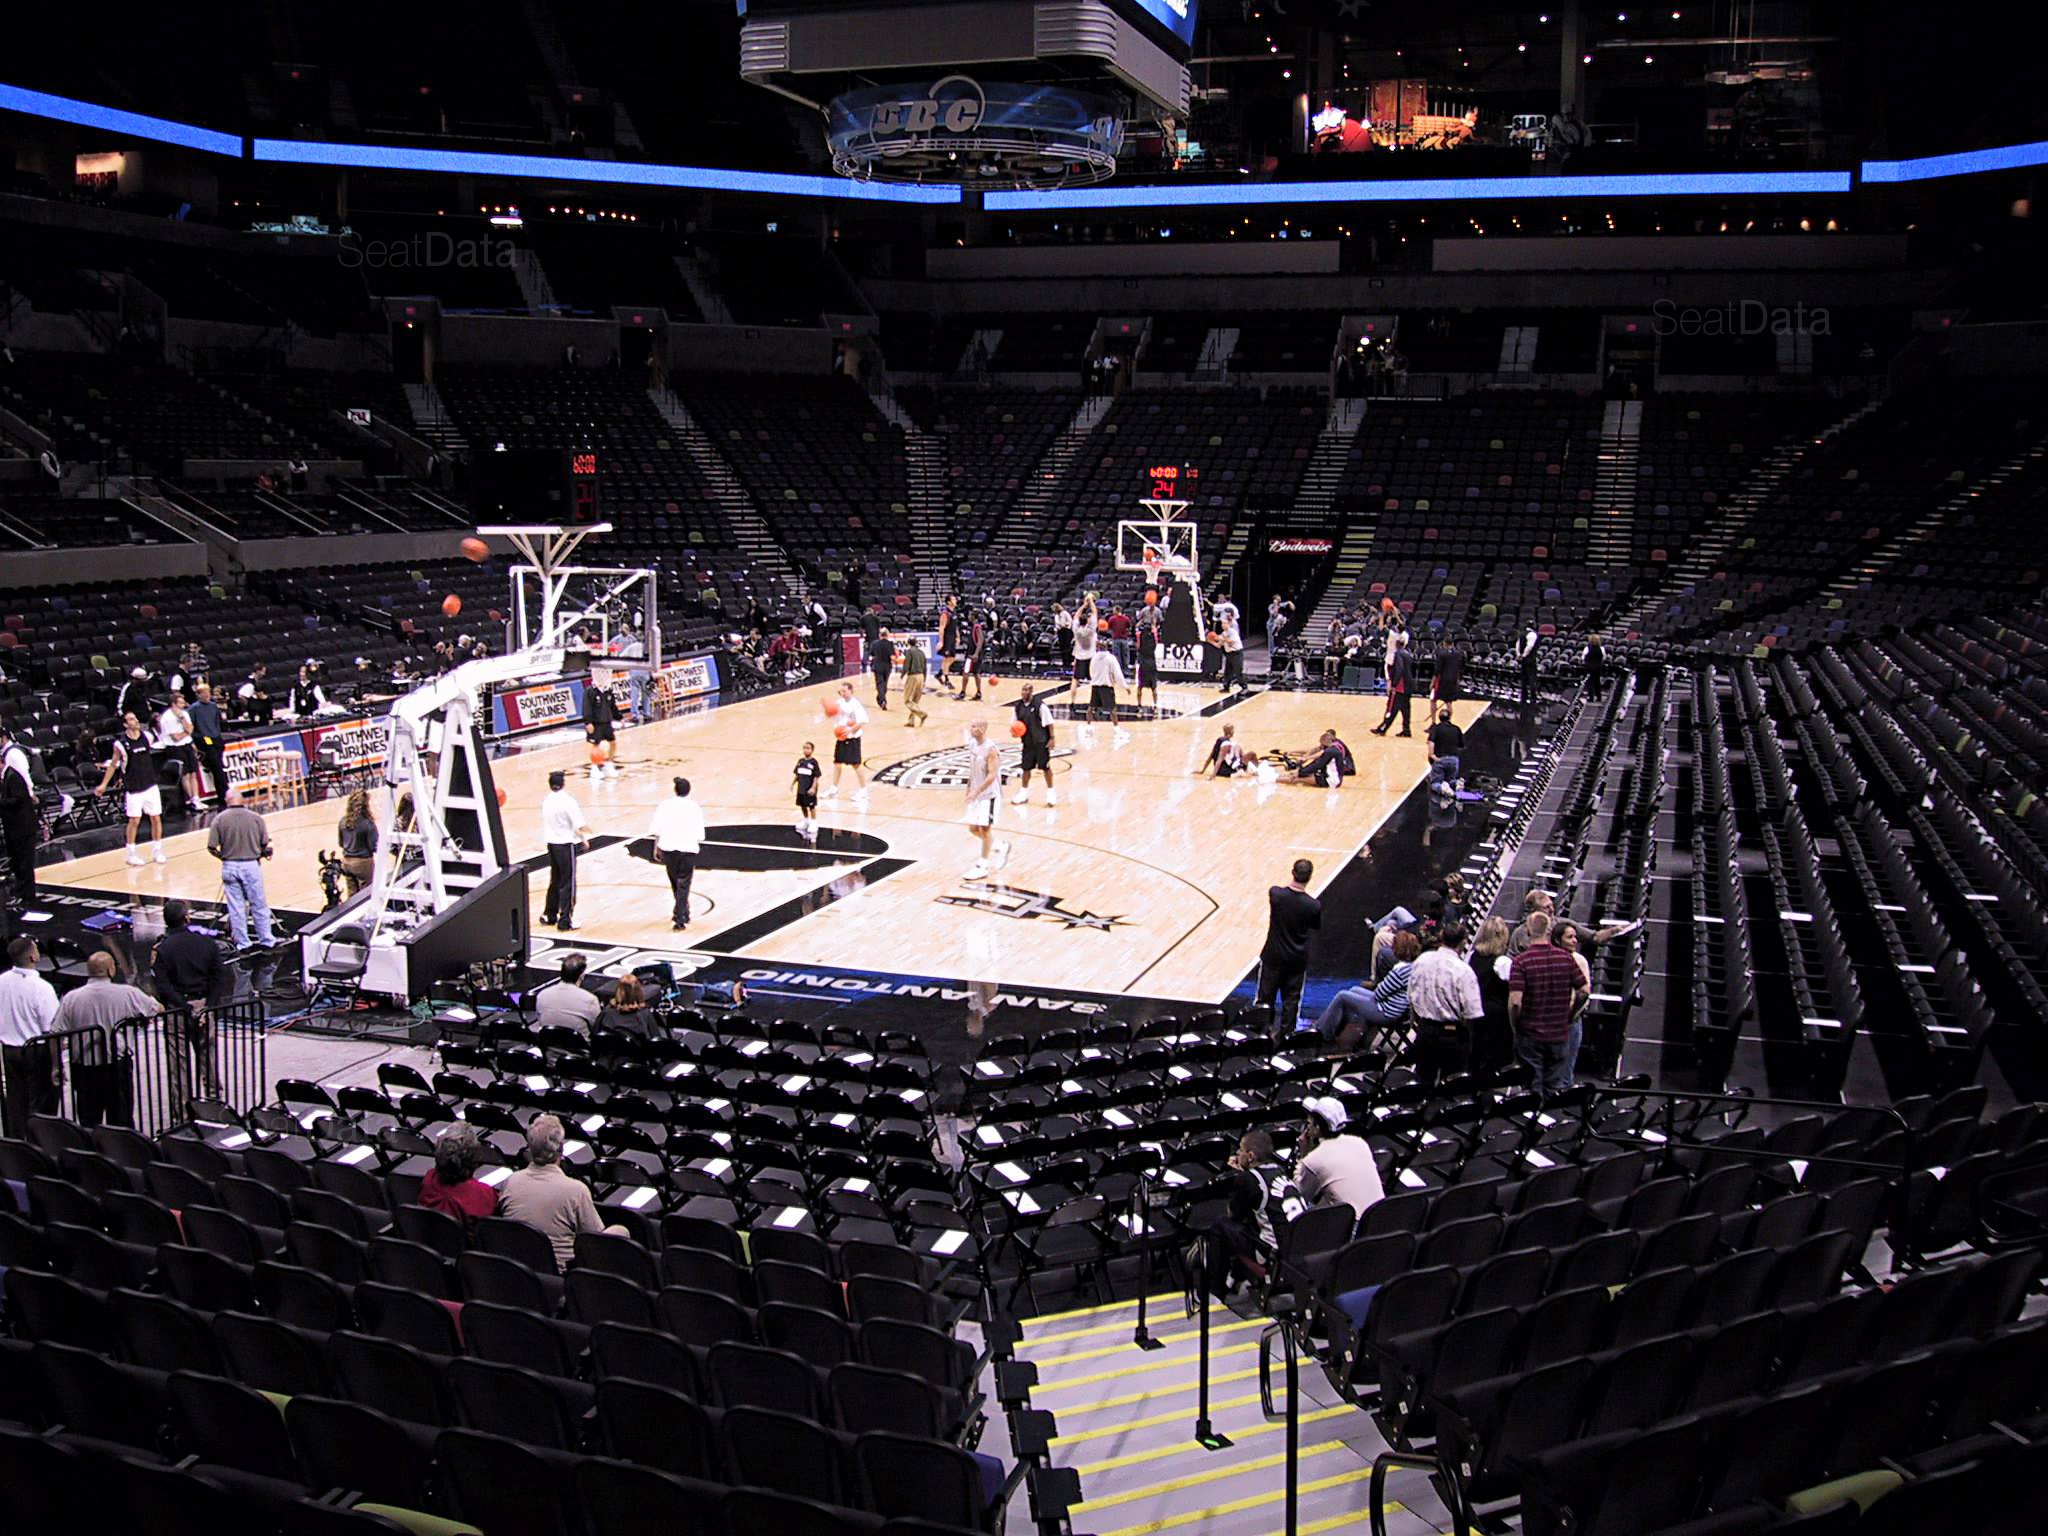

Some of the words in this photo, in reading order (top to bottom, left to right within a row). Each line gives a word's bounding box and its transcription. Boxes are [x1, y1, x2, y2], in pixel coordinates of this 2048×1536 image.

[872, 98, 981, 134] SBC
[1152, 480, 1175, 499] 24
[1163, 643, 1195, 661] FOX
[520, 690, 570, 710] SOUTHWEST
[530, 703, 567, 719] AIRLINES
[739, 968, 979, 1003] ANTONIO
[989, 993, 1110, 1016] SAN
